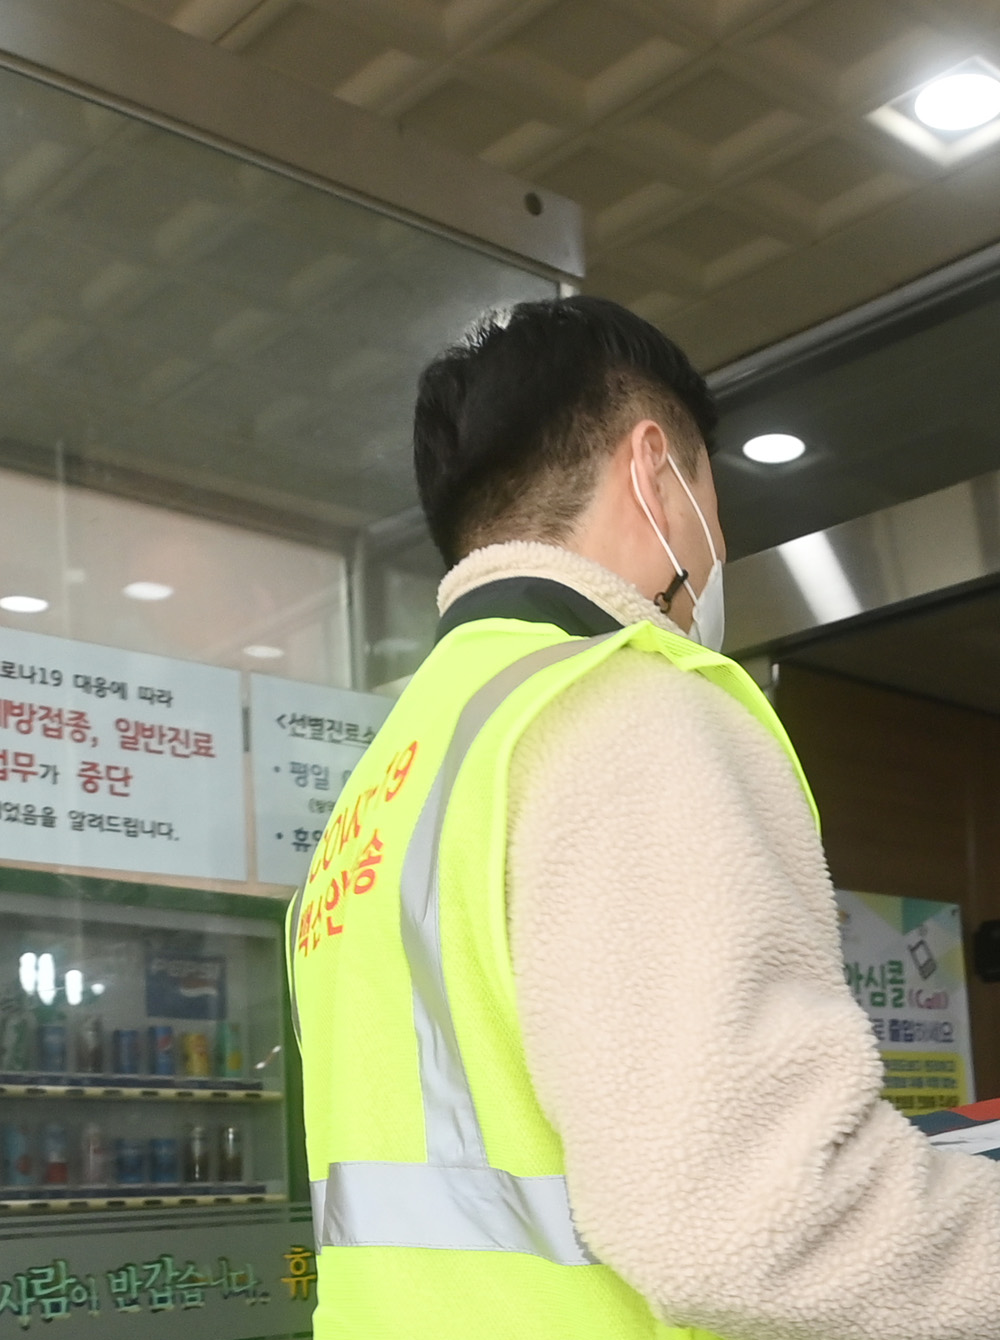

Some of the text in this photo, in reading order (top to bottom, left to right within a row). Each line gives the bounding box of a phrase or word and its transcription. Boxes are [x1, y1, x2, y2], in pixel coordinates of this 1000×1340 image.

[73, 673, 128, 701] 대응에
[138, 685, 173, 708] 따라
[115, 717, 216, 760] 일반진료
[77, 761, 133, 797] 중단
[289, 760, 330, 791] 평일
[68, 810, 181, 842] 알려드립니다.
